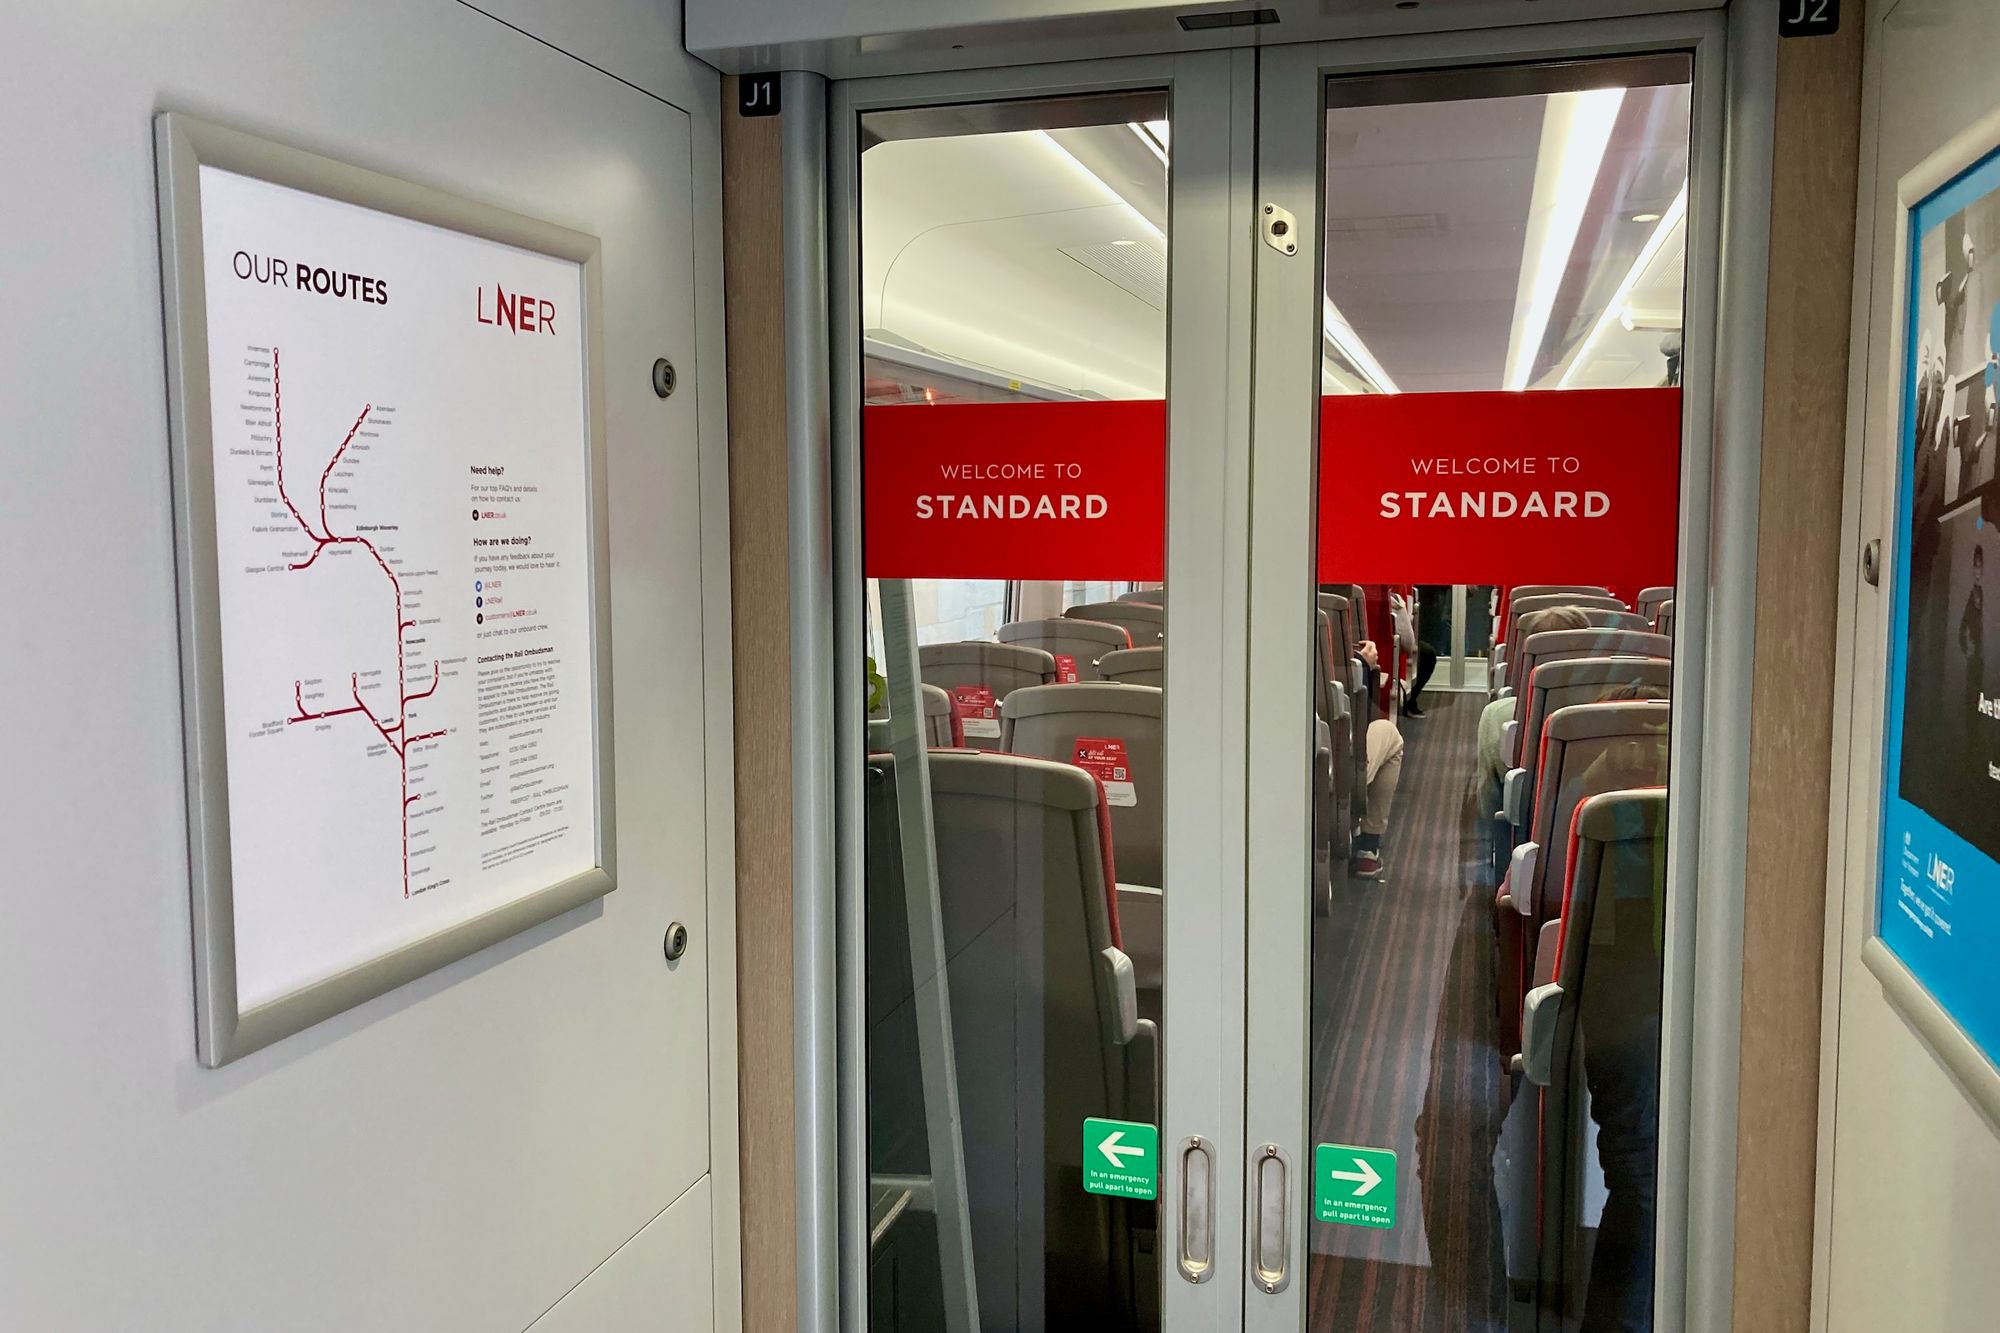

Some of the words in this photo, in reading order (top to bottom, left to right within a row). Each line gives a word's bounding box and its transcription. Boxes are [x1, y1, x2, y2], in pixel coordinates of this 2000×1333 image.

[1788, 0, 1828, 23] J2
[746, 82, 770, 106] J1
[232, 251, 288, 288] OUR
[296, 264, 388, 305] ROUTES
[478, 283, 556, 336] LNER
[471, 466, 487, 475] Need
[488, 466, 504, 476] help?
[940, 464, 1045, 480] WELCOME
[1054, 464, 1082, 479] TO
[1411, 458, 1536, 474] WELCOME
[1547, 456, 1580, 474] TO
[916, 494, 1108, 519] STANDARD
[1380, 491, 1610, 518] STANDARD
[473, 538, 487, 546] How
[511, 536, 532, 546] doing?
[477, 654, 504, 664] Contacting
[524, 647, 554, 656] Ombudsman
[1978, 692, 1993, 716] Are
[1927, 852, 1954, 896] LNER
[1110, 1172, 1150, 1184] emergency
[1339, 1212, 1360, 1220] apart
[1345, 1201, 1387, 1213] emergency
